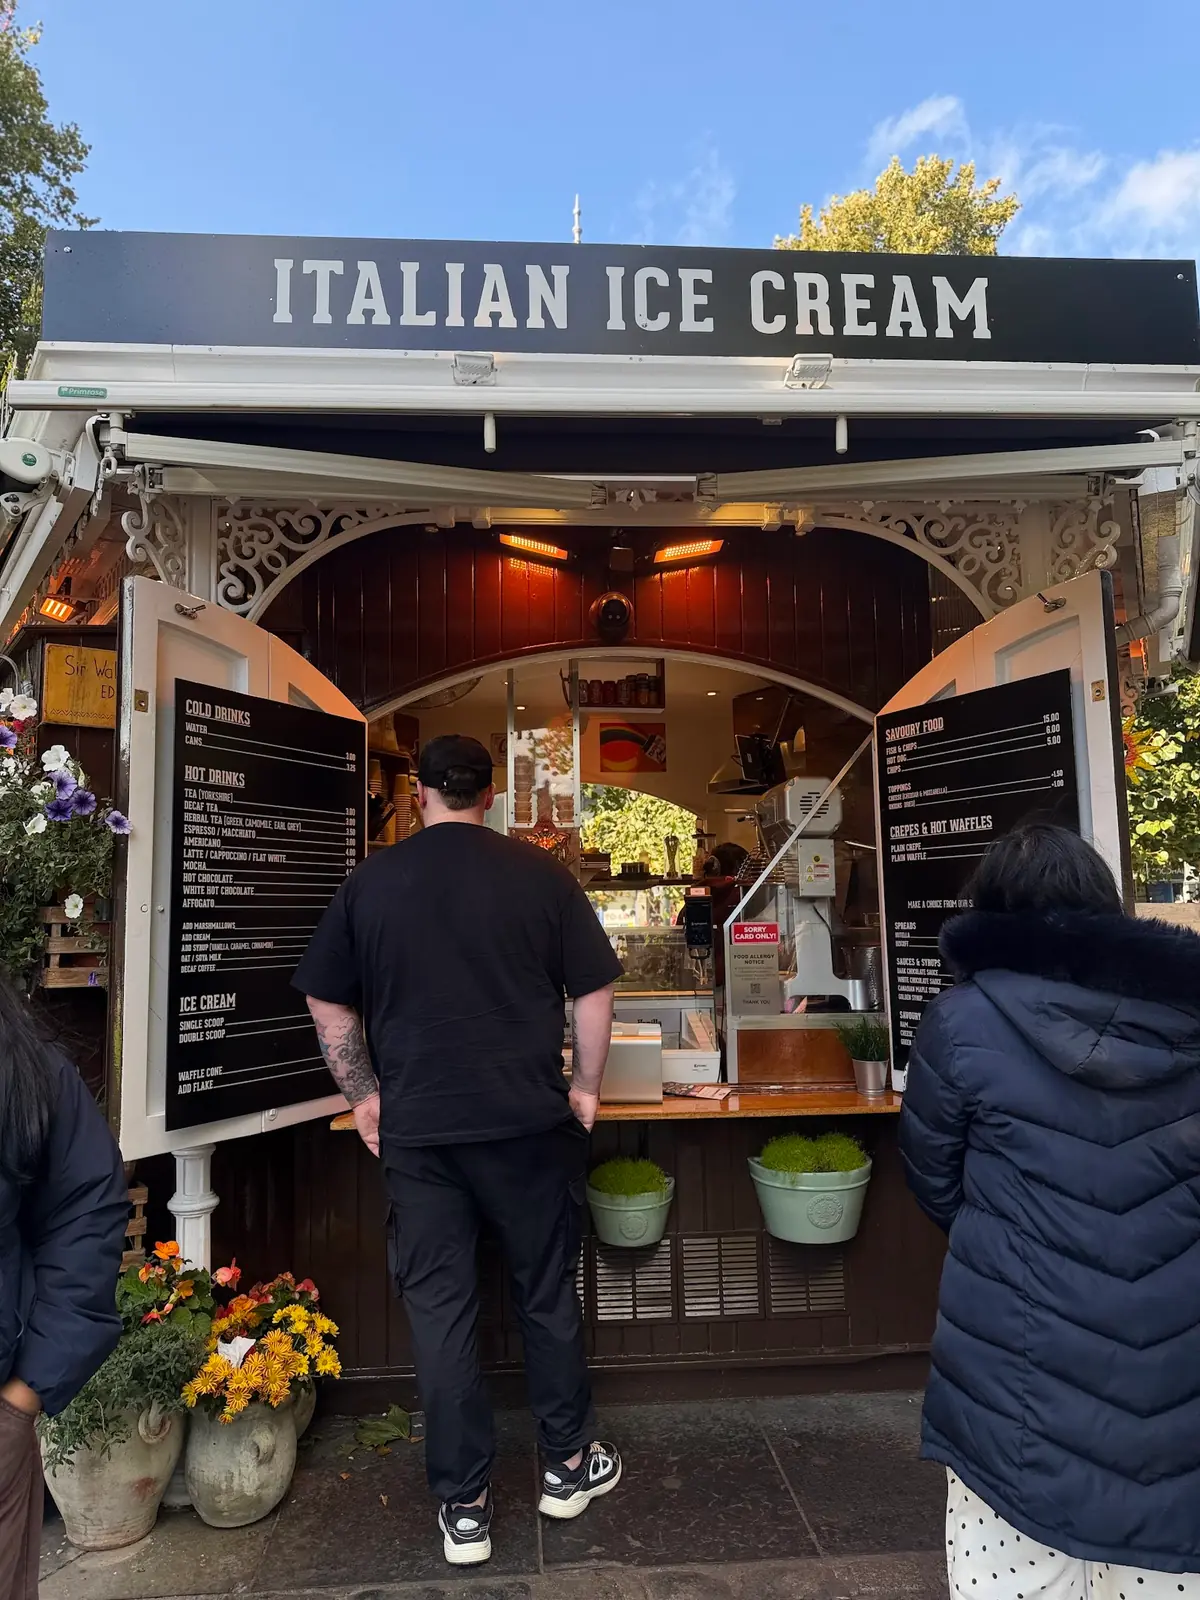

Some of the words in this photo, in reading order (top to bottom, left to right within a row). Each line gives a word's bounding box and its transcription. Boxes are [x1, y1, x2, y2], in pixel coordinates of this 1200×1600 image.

[272, 258, 570, 329] ITALIAN
[605, 266, 715, 333] ICE
[749, 270, 992, 340] CREAM
[68, 388, 104, 396] Primrose
[64, 654, 86, 676] Sir
[93, 658, 118, 679] Wal
[101, 684, 115, 699] ED
[185, 699, 212, 717] COLD
[214, 704, 251, 726] DRINKS
[1043, 712, 1059, 723] 15.00
[185, 722, 208, 734] WATER
[886, 722, 920, 740] SAVOURY
[923, 717, 944, 733] FOOD
[1046, 724, 1060, 734] 6.00
[184, 734, 202, 746] CANS
[1047, 735, 1061, 745] 5.00
[184, 765, 205, 781] HOT
[208, 769, 245, 787] DRINKS
[184, 788, 197, 798] TEA
[184, 800, 204, 811] DECAF
[206, 802, 218, 812] TEA
[184, 812, 208, 823] HERBAL
[210, 815, 222, 825] TEA
[184, 824, 215, 835] ESPRESSO
[222, 828, 256, 838] MACCHIATO
[890, 824, 919, 838] CREPES
[922, 822, 928, 834] &
[930, 820, 947, 833] HOT
[950, 815, 992, 832] WAFFLES
[184, 836, 221, 847] AMERICANO
[891, 844, 905, 853] PLAIN
[906, 842, 921, 851] CREPE
[183, 849, 204, 858] LATTE
[210, 850, 247, 861] CAPPUCCINO
[252, 854, 266, 862] FLAT
[268, 854, 286, 863] WHITE
[891, 854, 906, 862] PLAIN
[907, 852, 927, 861] WAFFLE
[183, 861, 206, 870] MOCHA
[183, 873, 196, 882] HOT
[198, 873, 233, 883] CHOCOLATE
[183, 885, 205, 895] WHITE
[207, 886, 219, 895] HOT
[221, 886, 254, 895] CHOCOLATE
[182, 898, 215, 908] AFFOGATO
[908, 900, 921, 908] MAKE
[926, 900, 942, 908] CHOICE
[895, 922, 916, 930] SPREADS
[198, 964, 216, 972] COFFEE
[180, 996, 196, 1012] ICE
[200, 993, 236, 1010] CREAM
[180, 1019, 202, 1031] SINGLE
[204, 1017, 224, 1028] SCOOP
[179, 1032, 204, 1043] DOUBLE
[205, 1029, 226, 1040] SCOOP
[178, 1068, 205, 1081] WAFFLE
[206, 1066, 223, 1076] CONE
[178, 1083, 192, 1094] ADD
[193, 1080, 213, 1091] FLAKE
